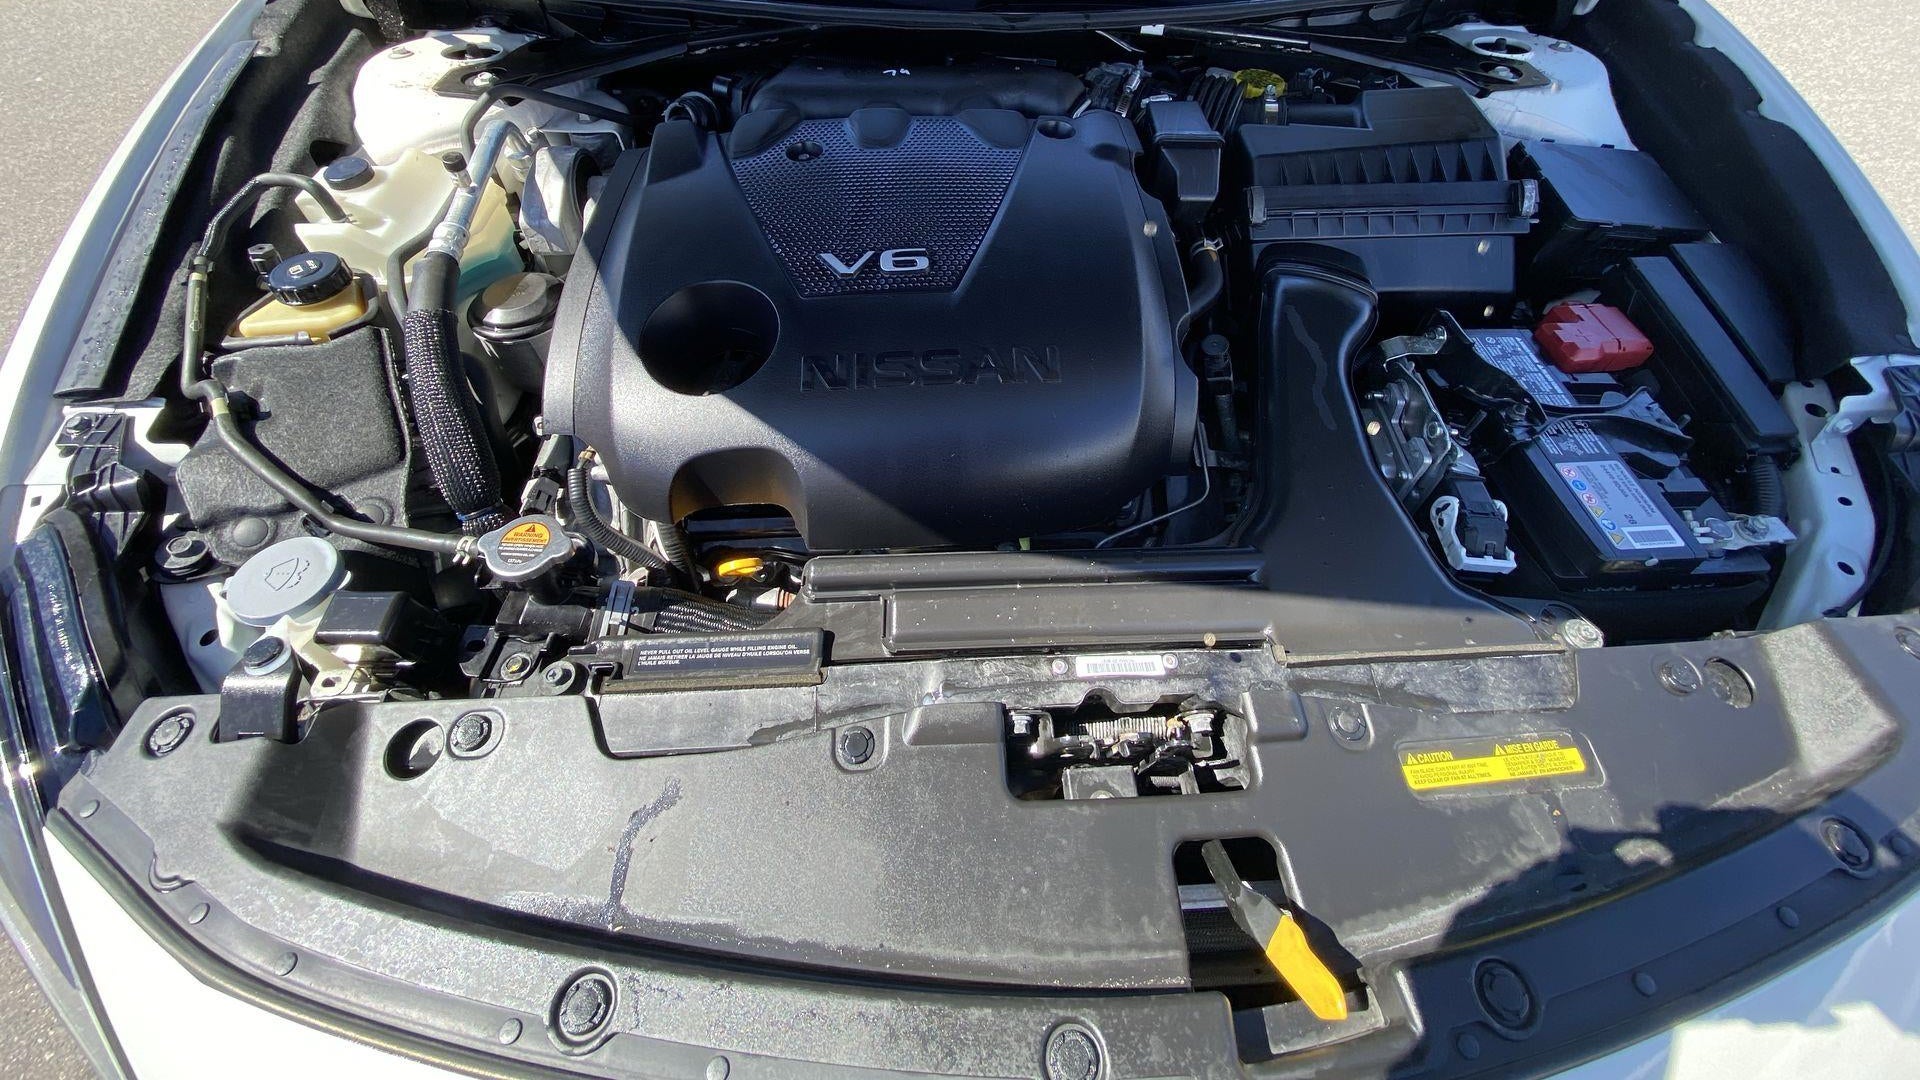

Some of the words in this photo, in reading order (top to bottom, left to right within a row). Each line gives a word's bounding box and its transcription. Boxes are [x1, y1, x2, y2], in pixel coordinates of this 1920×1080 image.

[818, 248, 930, 278] V6
[800, 347, 1062, 391] NISSAN
[1417, 751, 1454, 764] CAUTION
[1504, 743, 1523, 754] MISE
[1522, 742, 1534, 752] EN
[1533, 740, 1560, 751] GARDE
